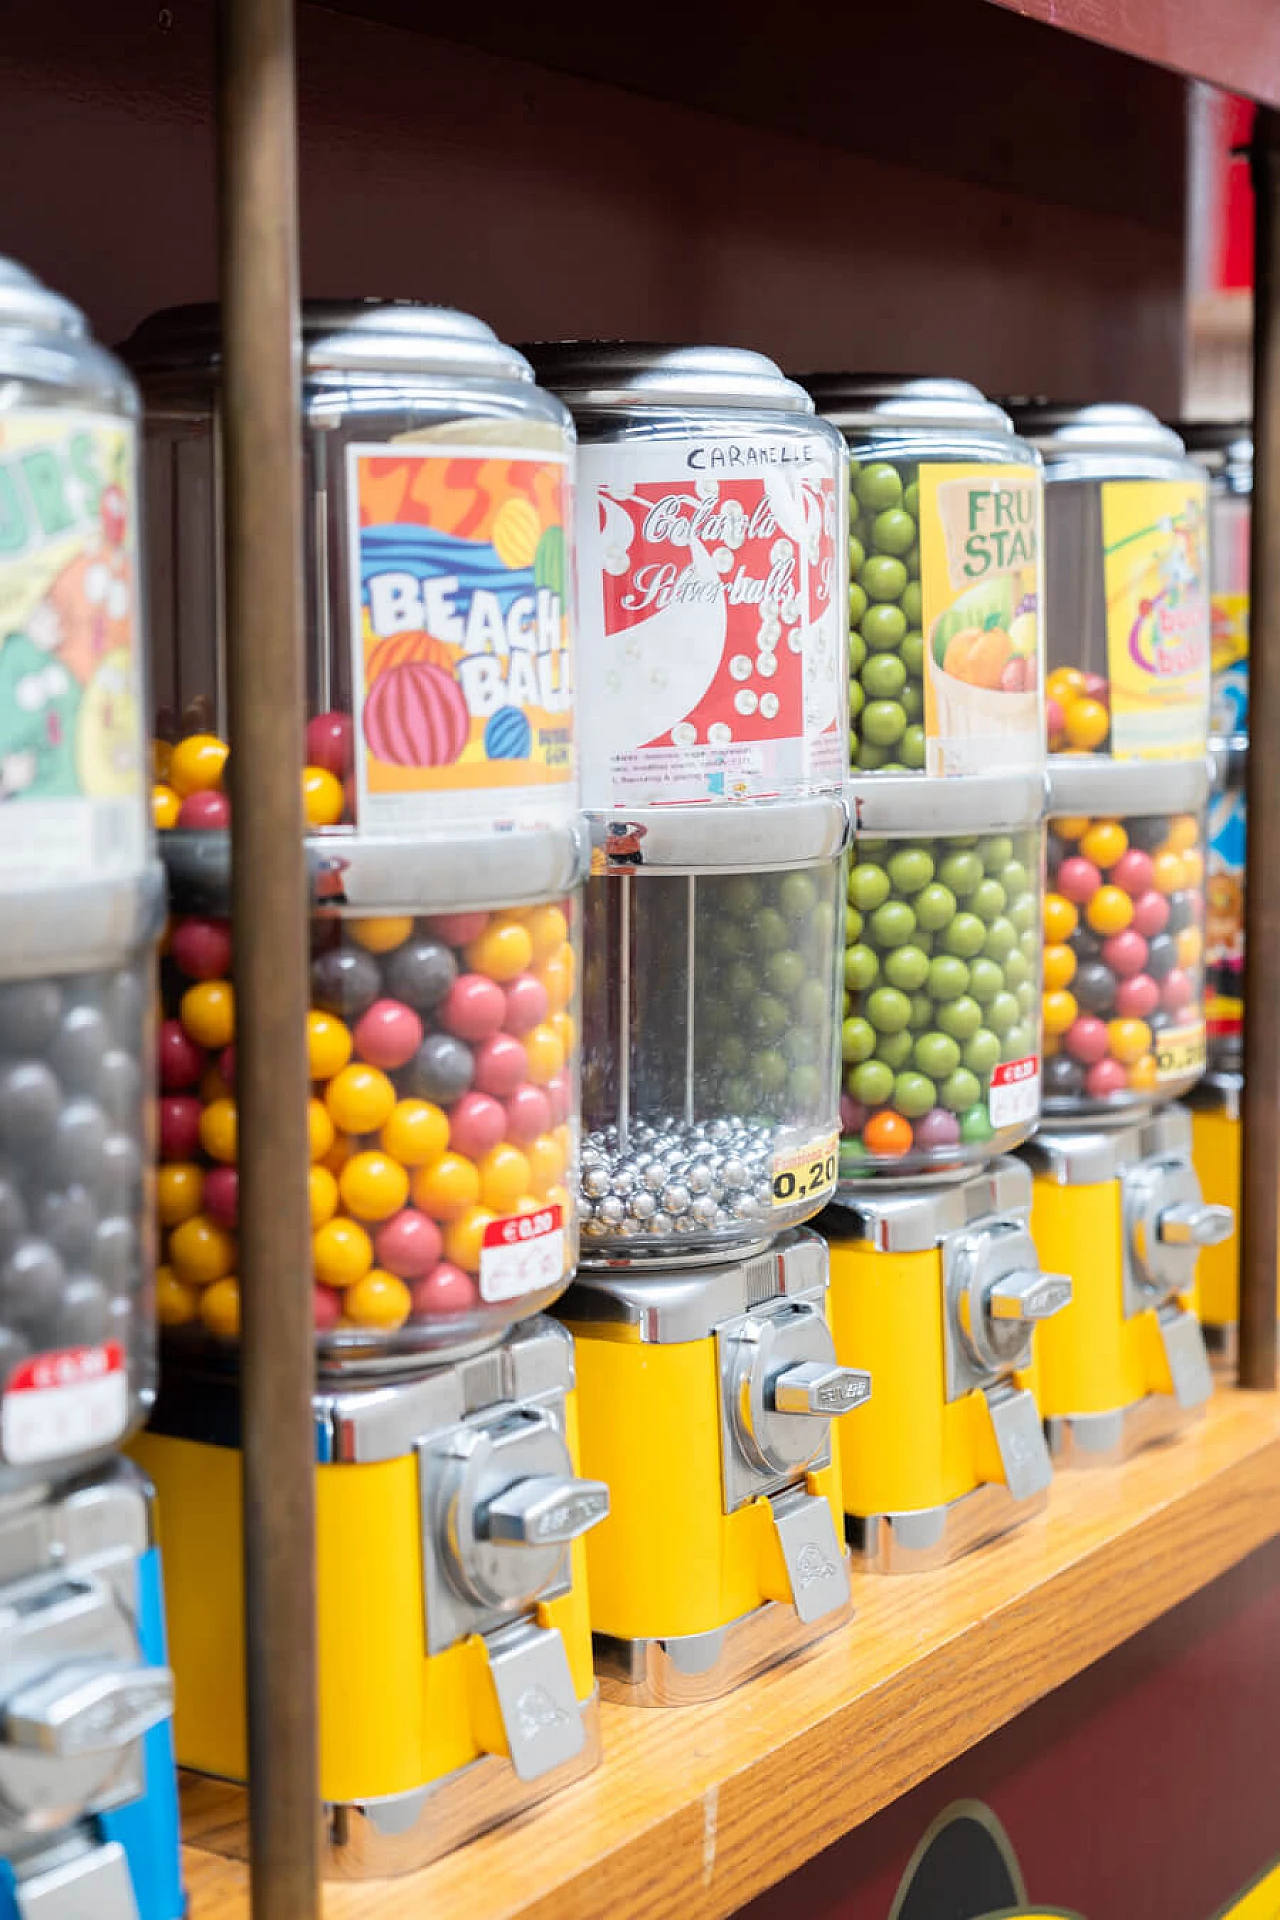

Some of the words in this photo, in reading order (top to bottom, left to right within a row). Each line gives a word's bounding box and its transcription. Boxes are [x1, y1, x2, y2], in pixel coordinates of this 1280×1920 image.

[687, 445, 813, 470] CARAMELLE
[368, 572, 562, 655] BEACH
[773, 1155, 836, 1199] 0,20
